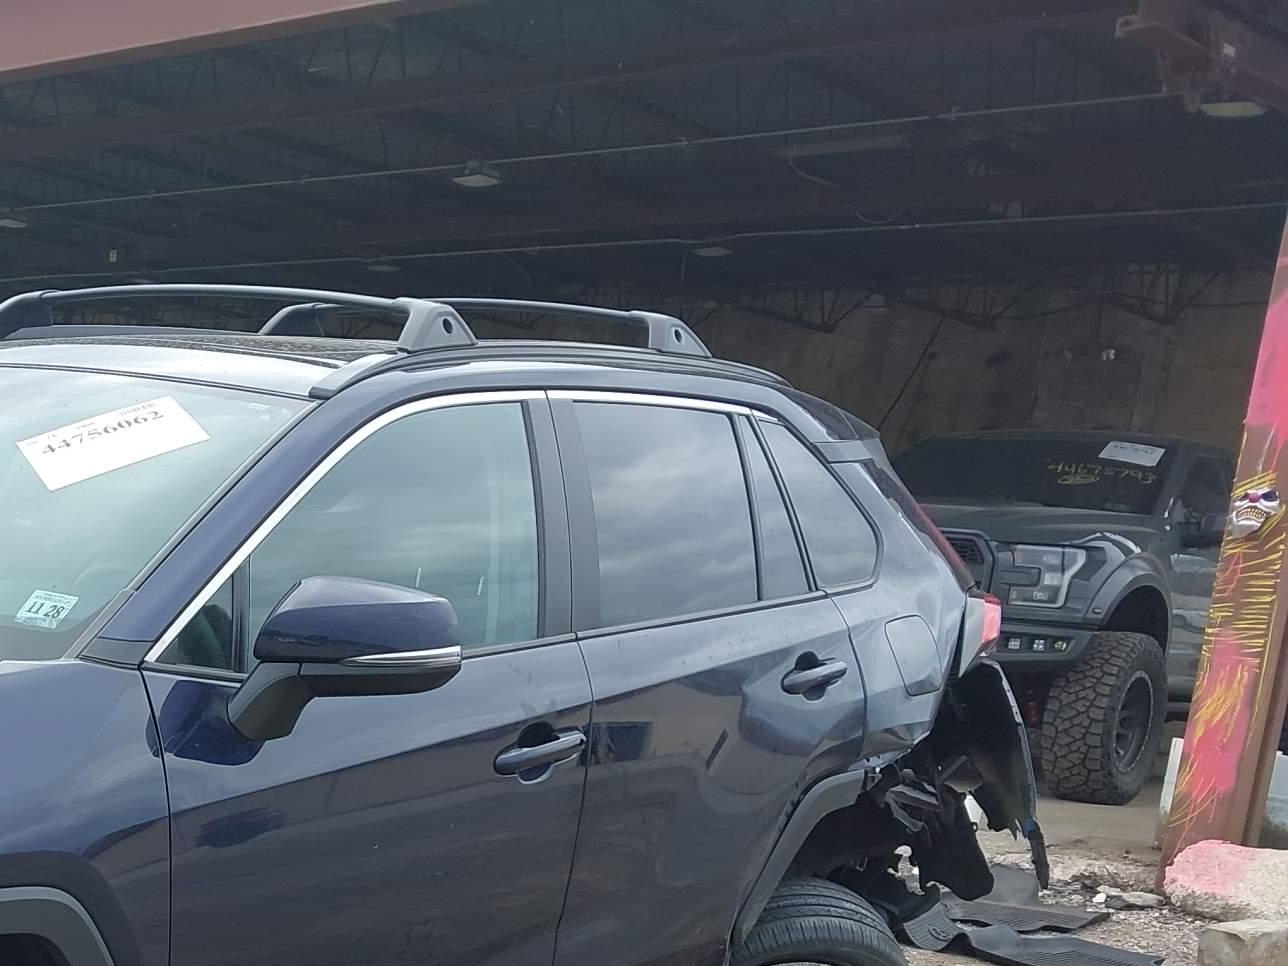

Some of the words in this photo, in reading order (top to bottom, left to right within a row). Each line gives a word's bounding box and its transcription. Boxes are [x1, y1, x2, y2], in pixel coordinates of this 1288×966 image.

[42, 411, 164, 455] 44756062
[25, 601, 45, 614] 11
[43, 604, 65, 618] 28
